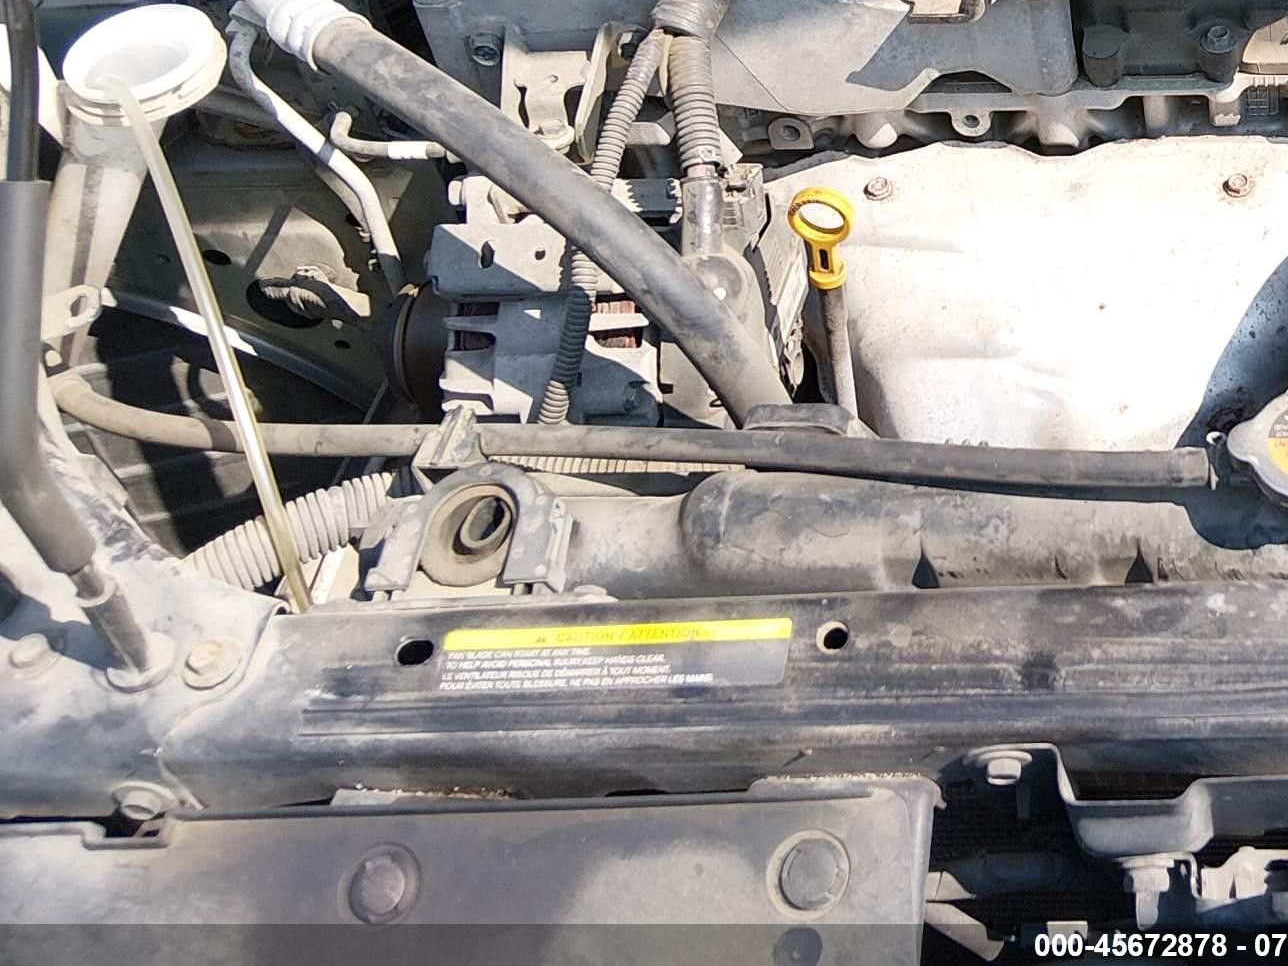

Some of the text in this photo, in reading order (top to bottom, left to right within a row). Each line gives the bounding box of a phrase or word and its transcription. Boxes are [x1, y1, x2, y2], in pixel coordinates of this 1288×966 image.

[555, 632, 615, 643] CAUTION
[629, 627, 700, 640] ATTENTION
[494, 650, 513, 659] CAN
[540, 649, 552, 657] AT
[446, 661, 457, 669] TO
[458, 660, 480, 669] HELP
[480, 660, 507, 669] AVOID
[508, 659, 551, 668] PERSONAL
[442, 673, 453, 681] LE
[454, 671, 508, 681] VENTILATEUR
[508, 670, 540, 679] RISQUE
[541, 669, 553, 677] DE
[609, 666, 632, 675] TOUT
[439, 682, 464, 690] POUR
[495, 680, 521, 689] TOUTE
[601, 676, 613, 686] EN
[614, 675, 668, 685] APPROCHER
[668, 674, 685, 684] LES
